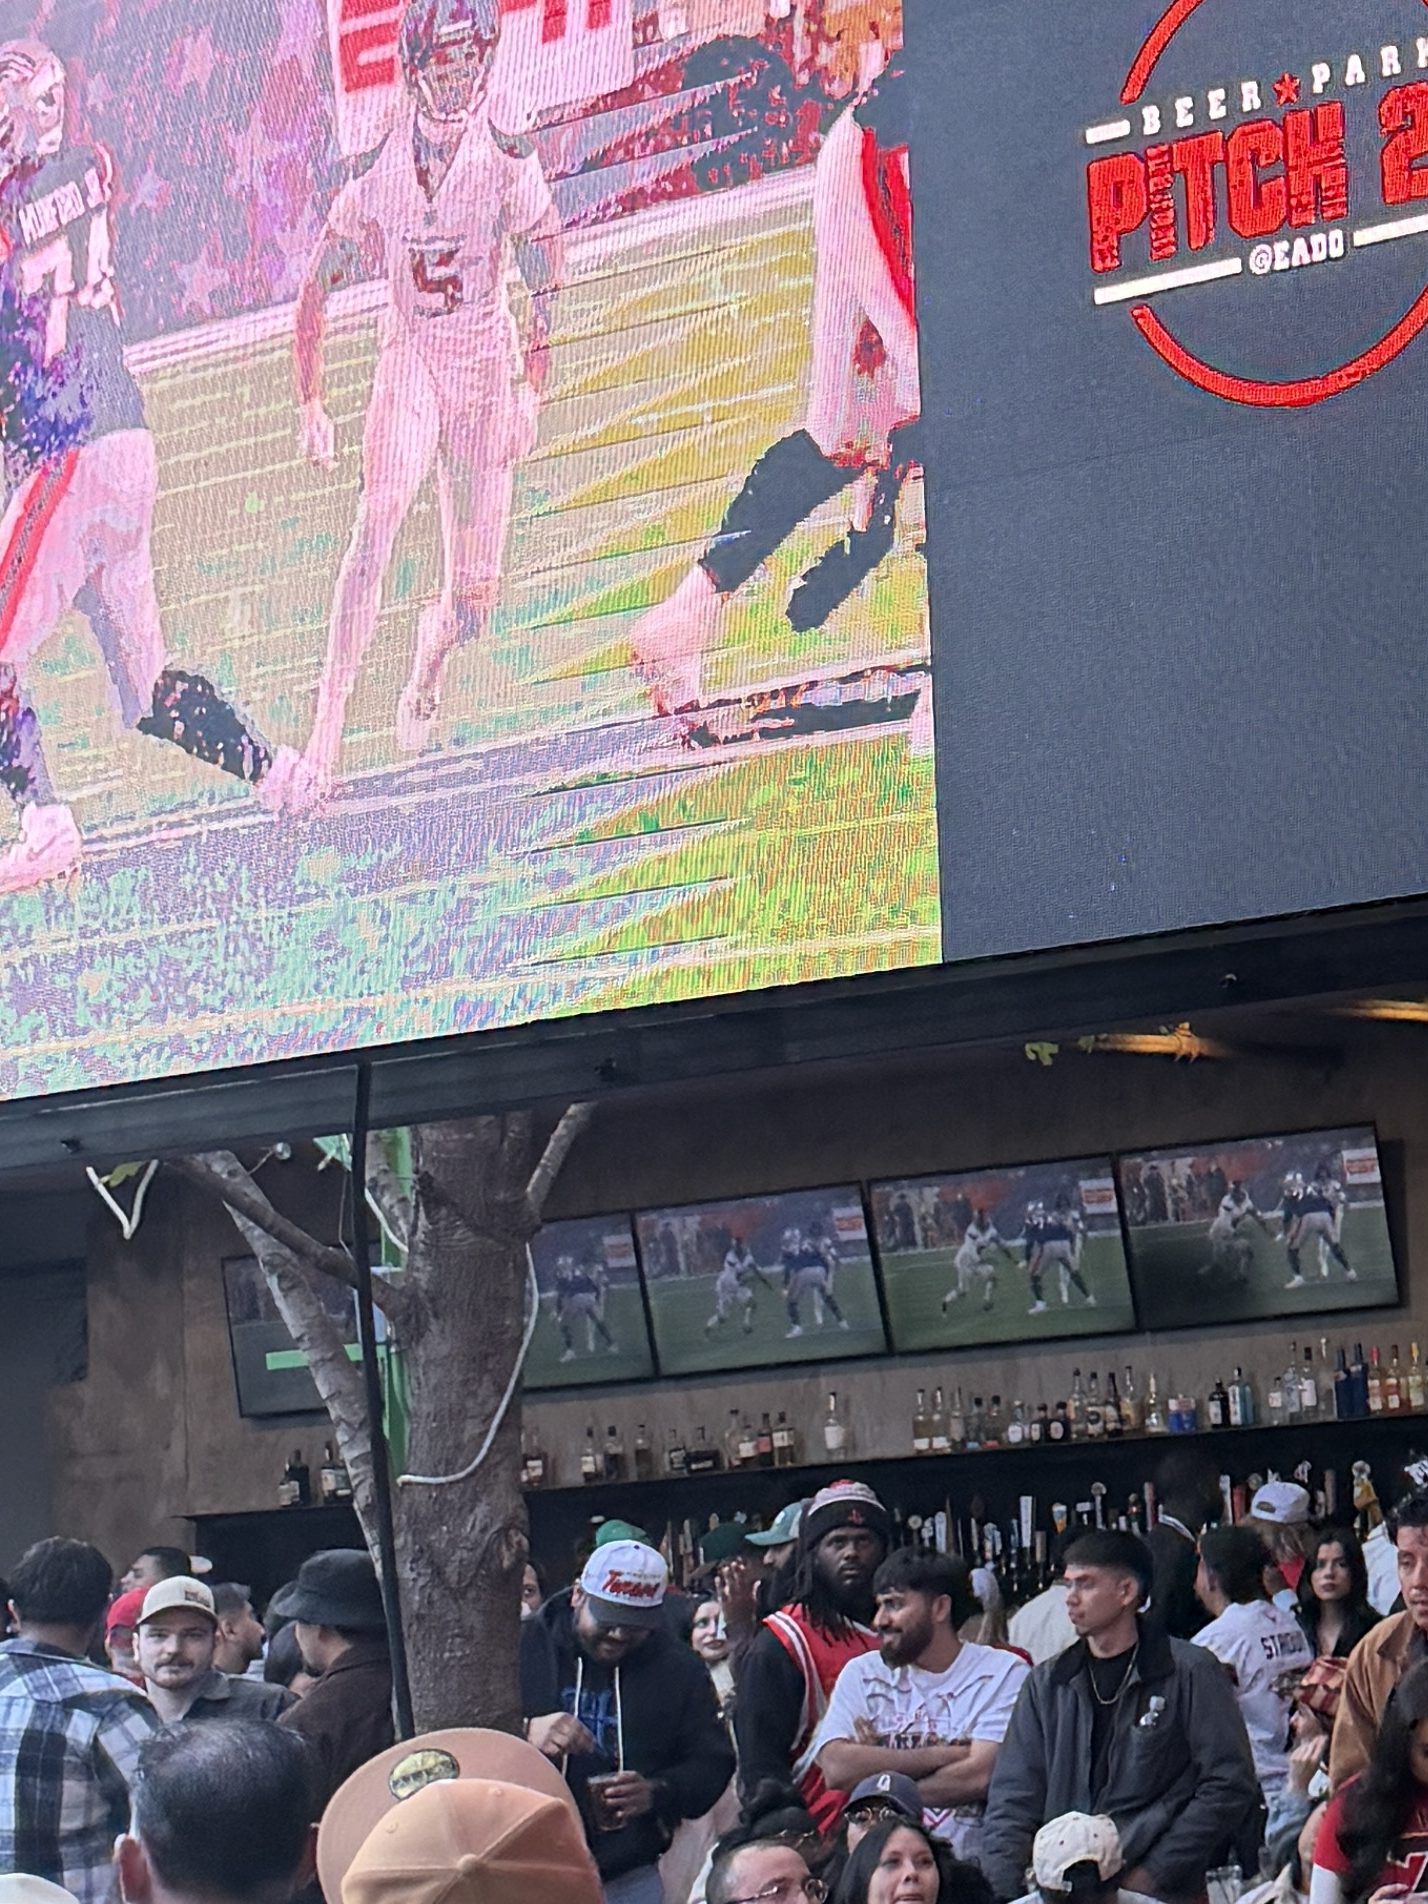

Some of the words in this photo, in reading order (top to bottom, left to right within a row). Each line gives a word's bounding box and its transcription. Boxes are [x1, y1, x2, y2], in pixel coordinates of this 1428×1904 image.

[1141, 80, 1262, 136] BEER
[1087, 101, 1349, 273] PITCH
[1249, 228, 1345, 275] @EADO
